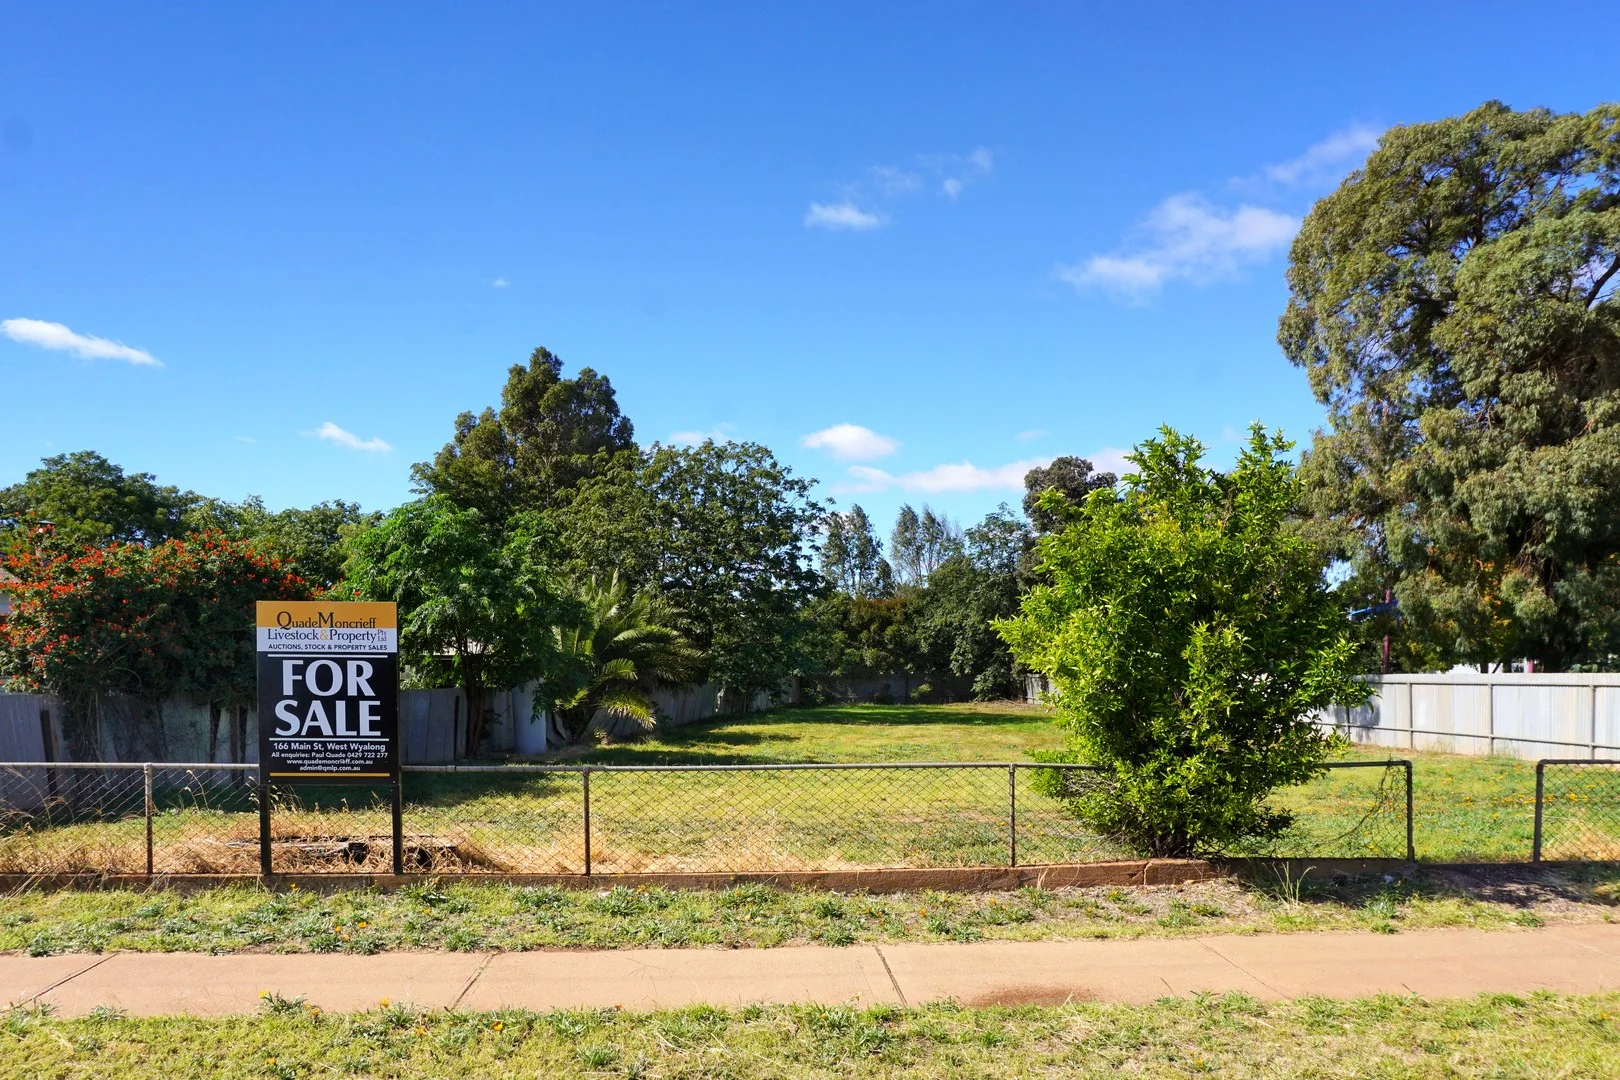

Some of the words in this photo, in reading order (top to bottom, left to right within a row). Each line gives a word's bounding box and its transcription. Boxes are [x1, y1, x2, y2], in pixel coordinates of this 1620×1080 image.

[282, 660, 376, 696] FOR
[275, 700, 381, 736] SALE
[350, 743, 386, 752] Wyalong
